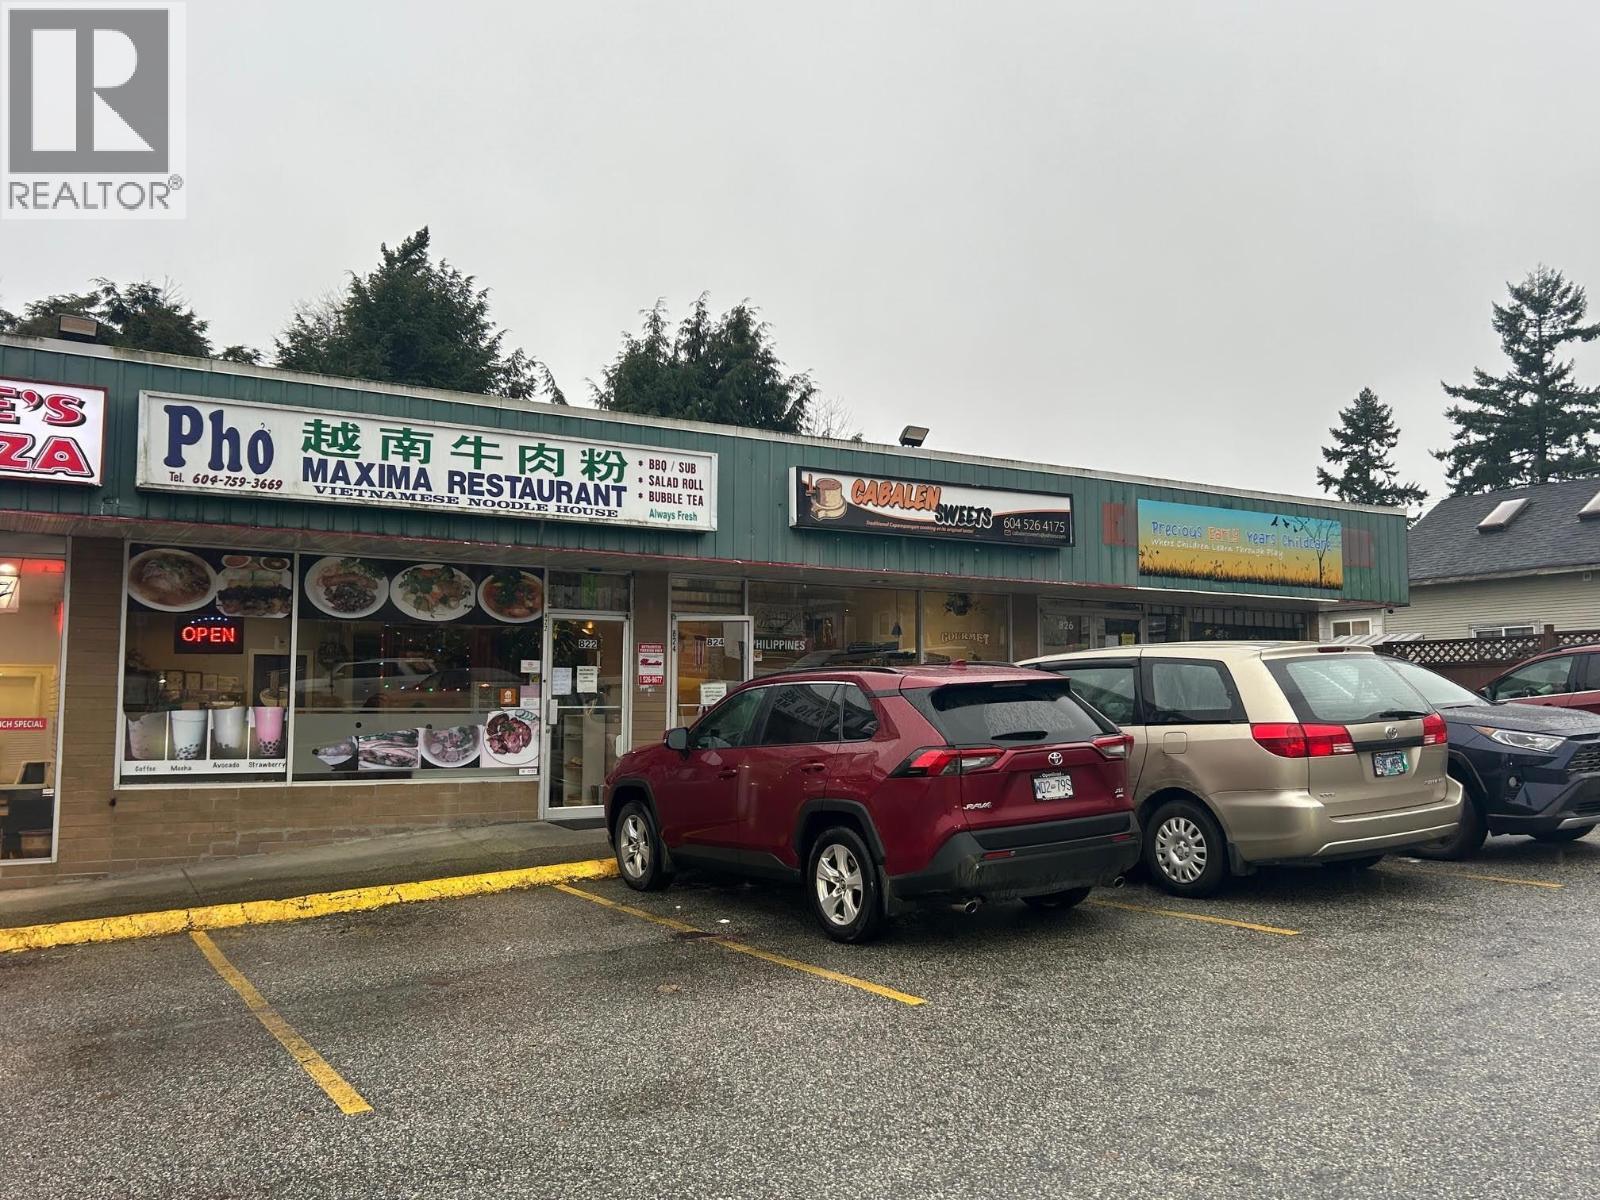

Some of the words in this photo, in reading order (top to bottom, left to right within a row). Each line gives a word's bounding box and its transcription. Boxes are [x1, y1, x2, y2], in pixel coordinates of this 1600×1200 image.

[301, 419, 629, 484] 越南牛肉粉
[648, 458, 667, 473] BBQ
[678, 462, 696, 474] SUB
[169, 471, 184, 483] Tel.
[192, 473, 283, 490] 604-759-3669
[302, 456, 432, 492] MAXIMA
[447, 470, 627, 508] RESTAURANT
[648, 474, 679, 489] SALAD
[682, 478, 704, 491] ROLL
[313, 485, 460, 504] VIETNAMESE
[467, 497, 548, 512] NOODLE
[555, 505, 618, 518] HOUSE
[648, 491, 683, 505] BUBBLE
[687, 494, 704, 507] TEA
[850, 478, 942, 511] CABALEN
[649, 508, 675, 522] Always
[677, 511, 698, 521] Fresh
[935, 503, 993, 528] SWEETS
[1003, 517, 1021, 529] 604
[1023, 518, 1041, 531] 526
[1042, 520, 1065, 533] 4175
[1152, 521, 1202, 538] Precious
[1246, 531, 1277, 546] Years
[182, 626, 235, 642] OPEN
[580, 640, 598, 648] 822
[707, 638, 724, 647] 824
[14, 720, 43, 728] SPECIAL
[135, 765, 156, 773] Coffee
[248, 761, 287, 769] Strawberry
